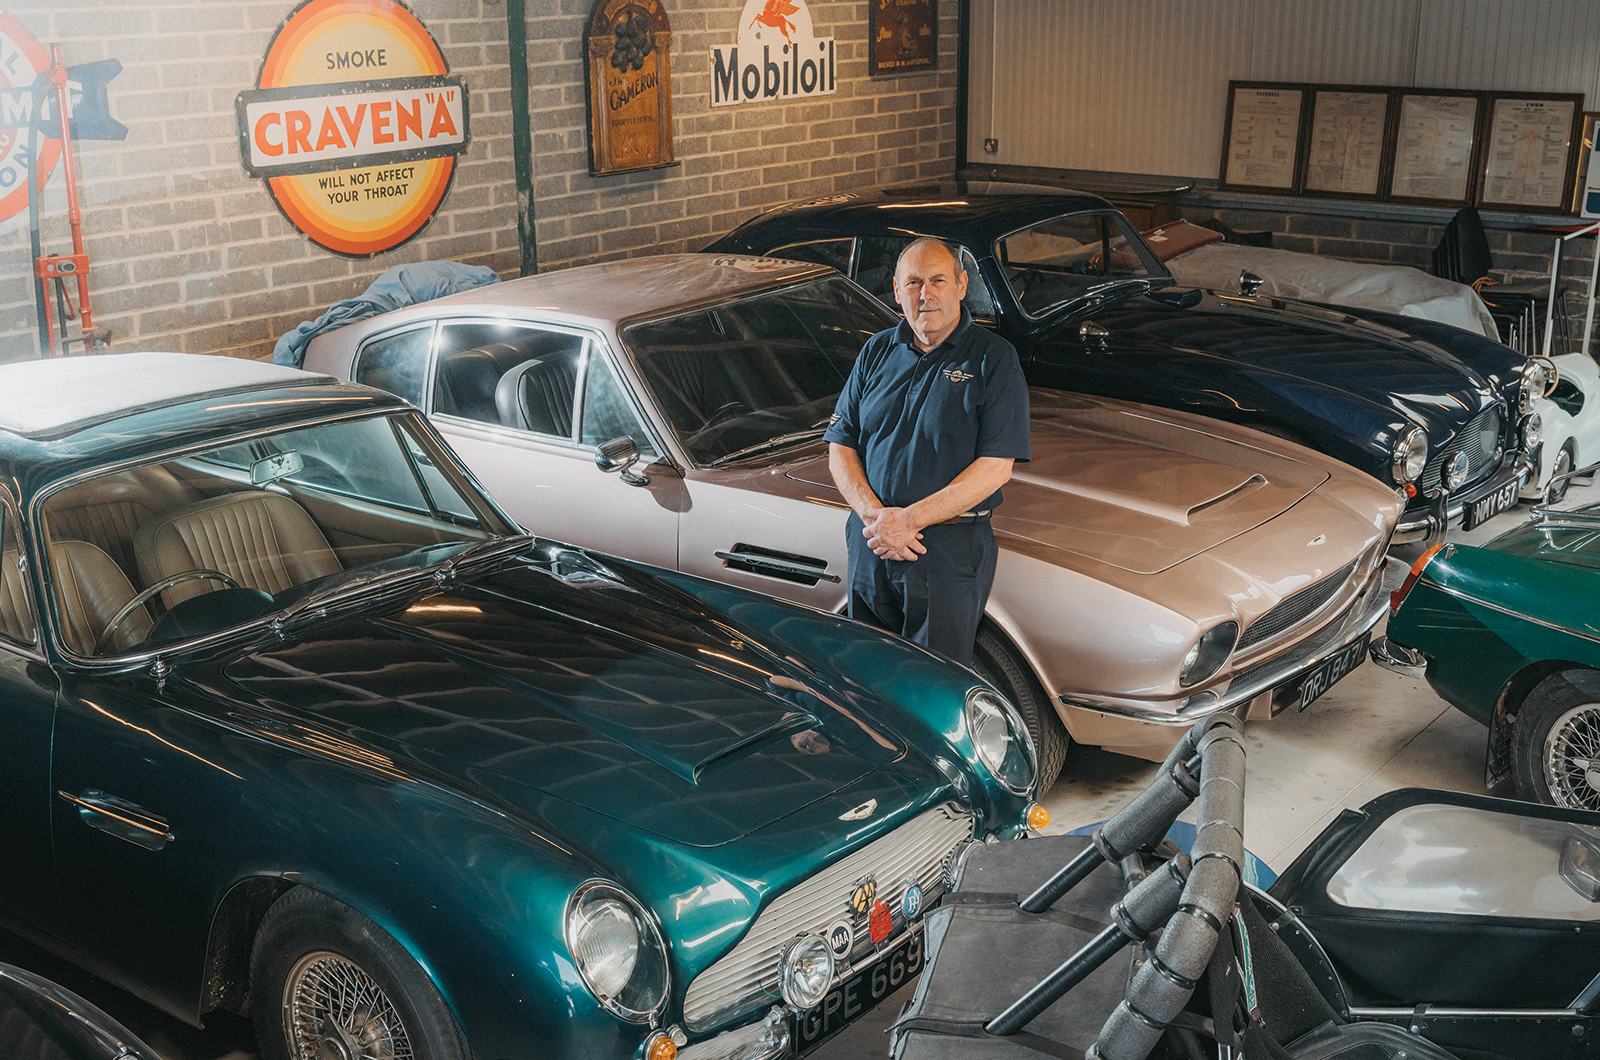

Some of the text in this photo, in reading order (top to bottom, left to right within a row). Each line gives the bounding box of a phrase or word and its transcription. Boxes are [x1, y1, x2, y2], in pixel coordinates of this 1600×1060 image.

[325, 49, 387, 70] SMOKE
[713, 40, 835, 103] Mobiloil
[609, 71, 659, 111] CAMERON
[254, 90, 458, 157] CRAVEN "A"
[318, 167, 415, 190] WILL NOT AFFECT
[327, 183, 409, 205] YOUR THROAT
[1475, 481, 1517, 525] NMY 657
[1301, 664, 1332, 708] DRJ
[831, 930, 850, 951] MAA
[802, 975, 862, 1041] GPE
